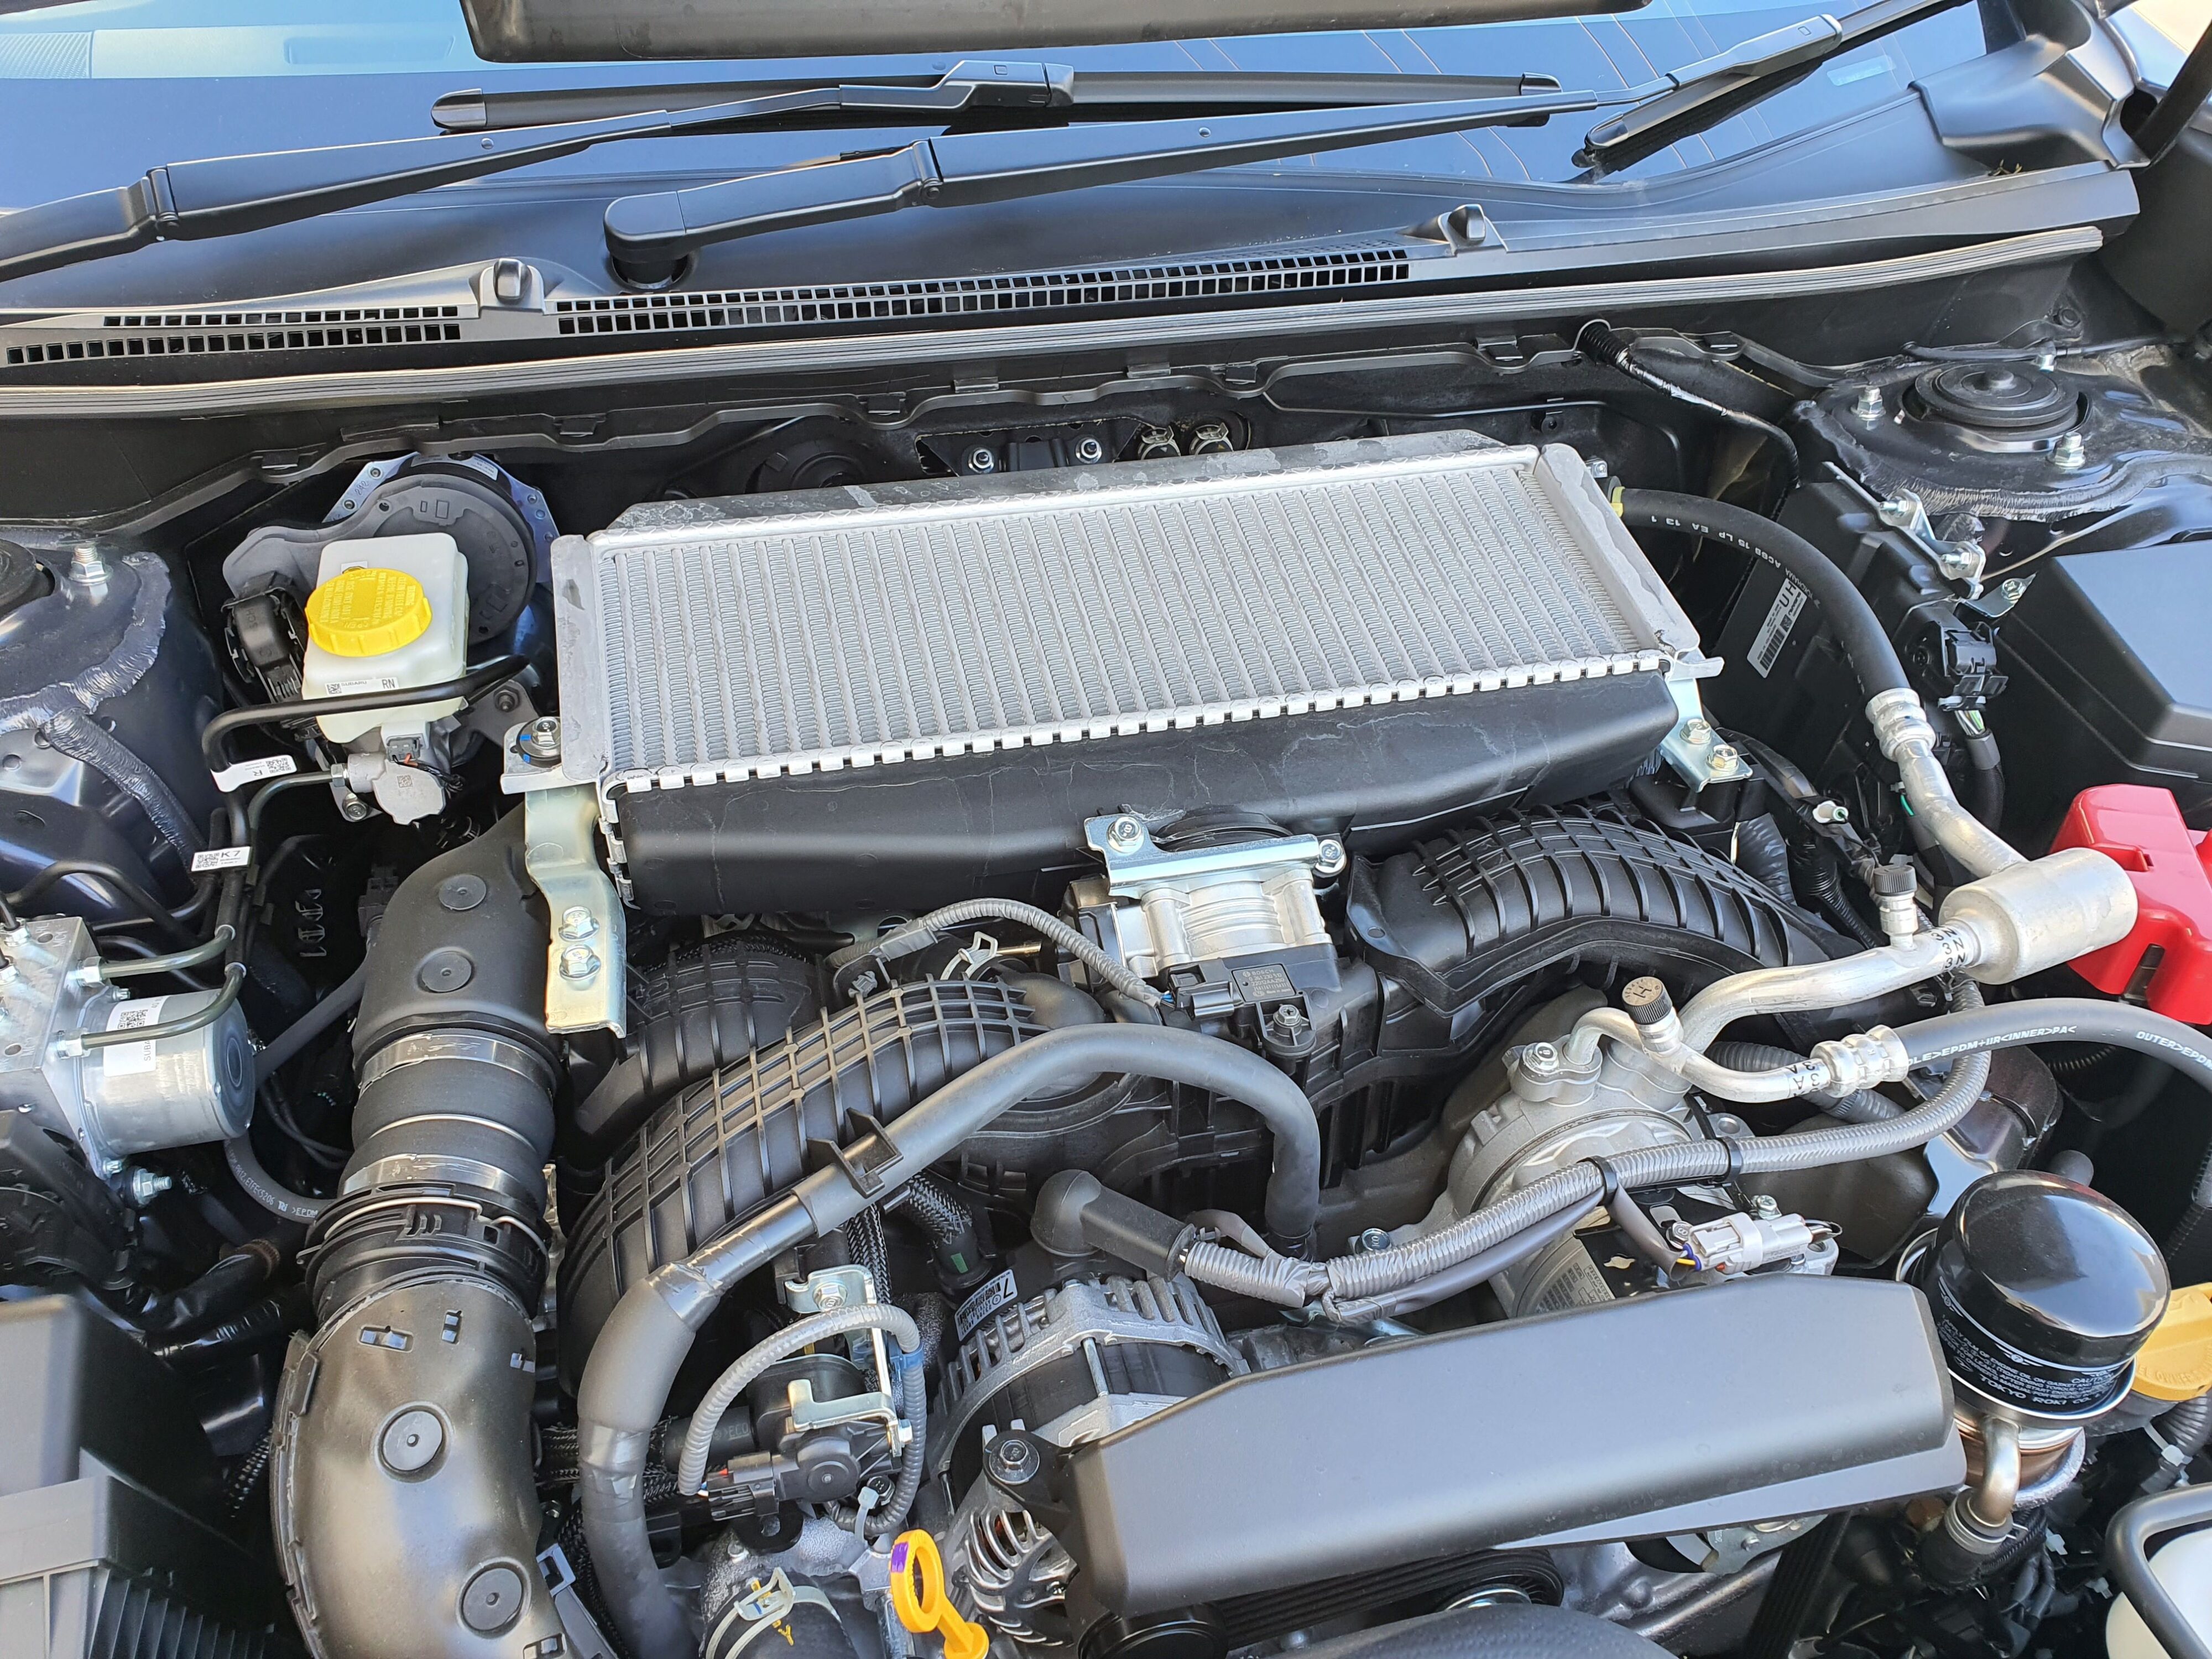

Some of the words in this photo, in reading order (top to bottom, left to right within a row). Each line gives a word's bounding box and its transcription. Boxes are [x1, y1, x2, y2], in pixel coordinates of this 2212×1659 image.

[1666, 518, 1681, 526] 13
[1692, 523, 1709, 534] EA
[1718, 531, 1734, 542] LP
[1738, 539, 1750, 550] 15
[1779, 581, 1797, 608] UH
[382, 678, 396, 690] RN
[1003, 1277, 1014, 1299] 7
[1979, 1350, 1991, 1358] OF
[1991, 1357, 2020, 1375] ENGINE
[2020, 1371, 2032, 1381] OIL
[2033, 1375, 2047, 1384] ON
[1979, 1374, 2027, 1399] TOKYO
[2032, 1396, 2067, 1405] ROKI
[1999, 1379, 2031, 1394] MANUAL
[2000, 1373, 2025, 1387] AFTER
[2026, 1384, 2051, 1394] START
